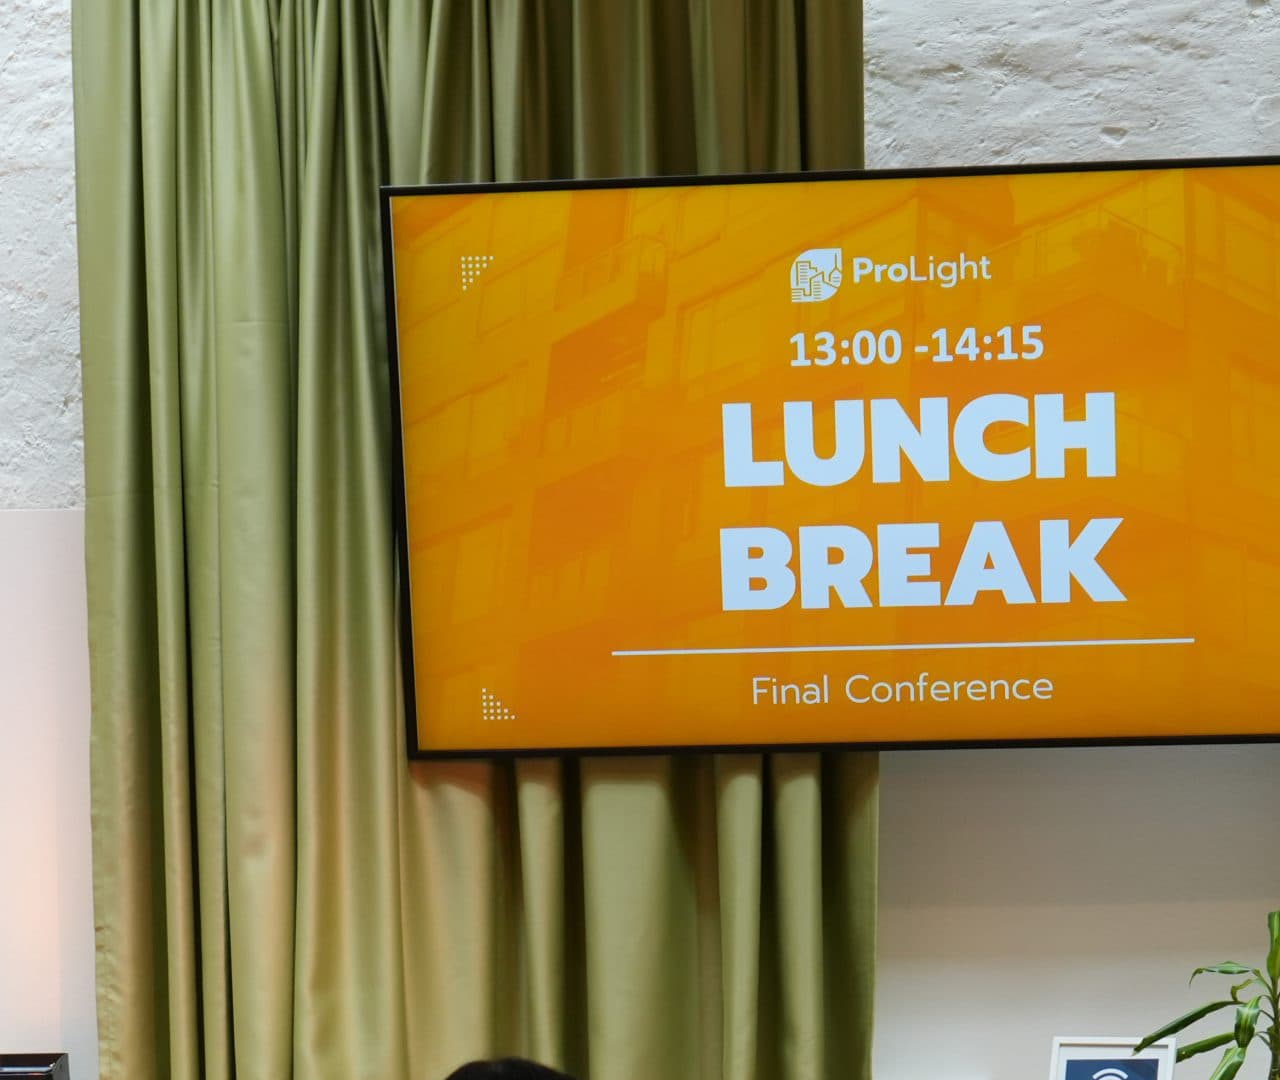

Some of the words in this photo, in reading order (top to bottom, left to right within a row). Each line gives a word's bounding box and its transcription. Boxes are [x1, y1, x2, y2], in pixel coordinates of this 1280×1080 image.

[852, 252, 992, 289] ProLight
[789, 329, 903, 367] 13:00
[913, 325, 1045, 363] -14:15
[721, 391, 1117, 488] LUNCH
[719, 517, 1128, 612] BREAK
[751, 674, 829, 705] Final
[845, 672, 1054, 704] Conference
